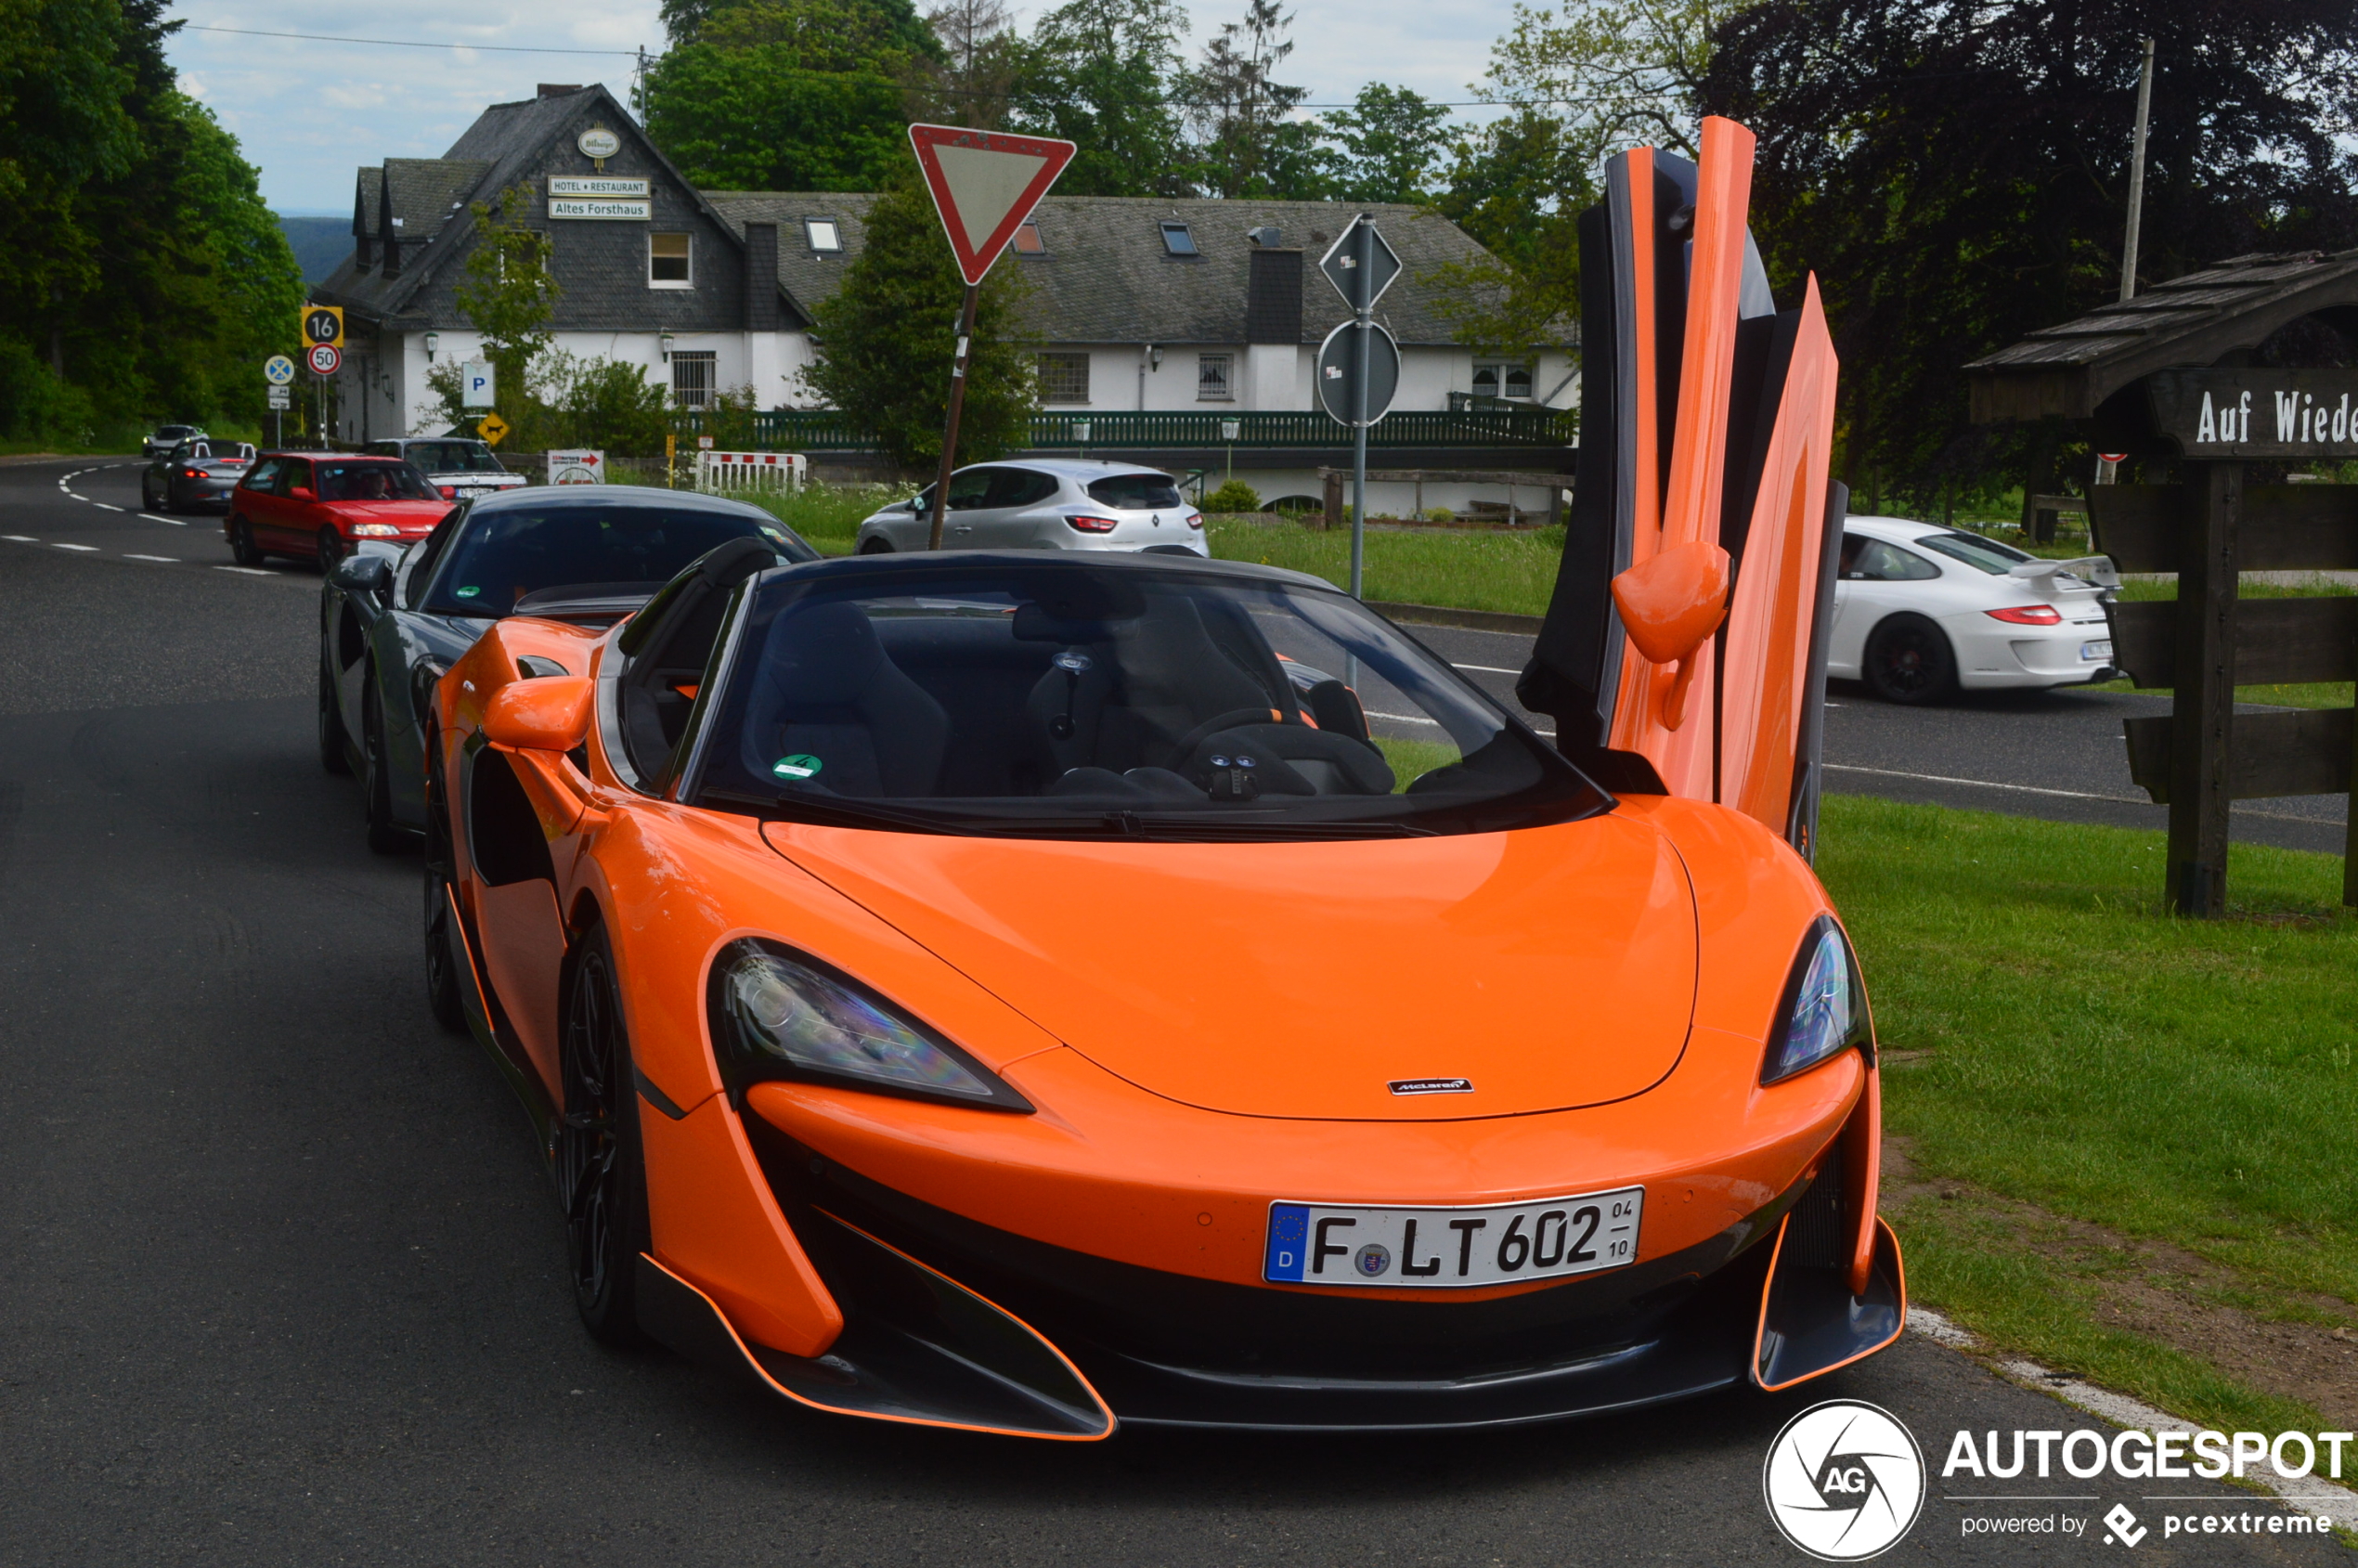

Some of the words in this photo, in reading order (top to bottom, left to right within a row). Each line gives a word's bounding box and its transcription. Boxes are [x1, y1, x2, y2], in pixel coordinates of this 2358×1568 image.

[554, 182, 581, 191] HOTEL
[590, 183, 643, 192] RESTAURANT
[556, 202, 584, 214] Altes
[588, 203, 643, 215] Forsthaus
[312, 317, 333, 337] 16
[316, 352, 334, 366] 50
[473, 377, 486, 391] P
[2196, 391, 2251, 443] Auf
[1398, 1080, 1465, 1091] McLaren
[1613, 1200, 1632, 1218] 04
[1312, 1217, 1356, 1274] F
[1609, 1239, 1628, 1257] 10
[1278, 1251, 1293, 1267] D
